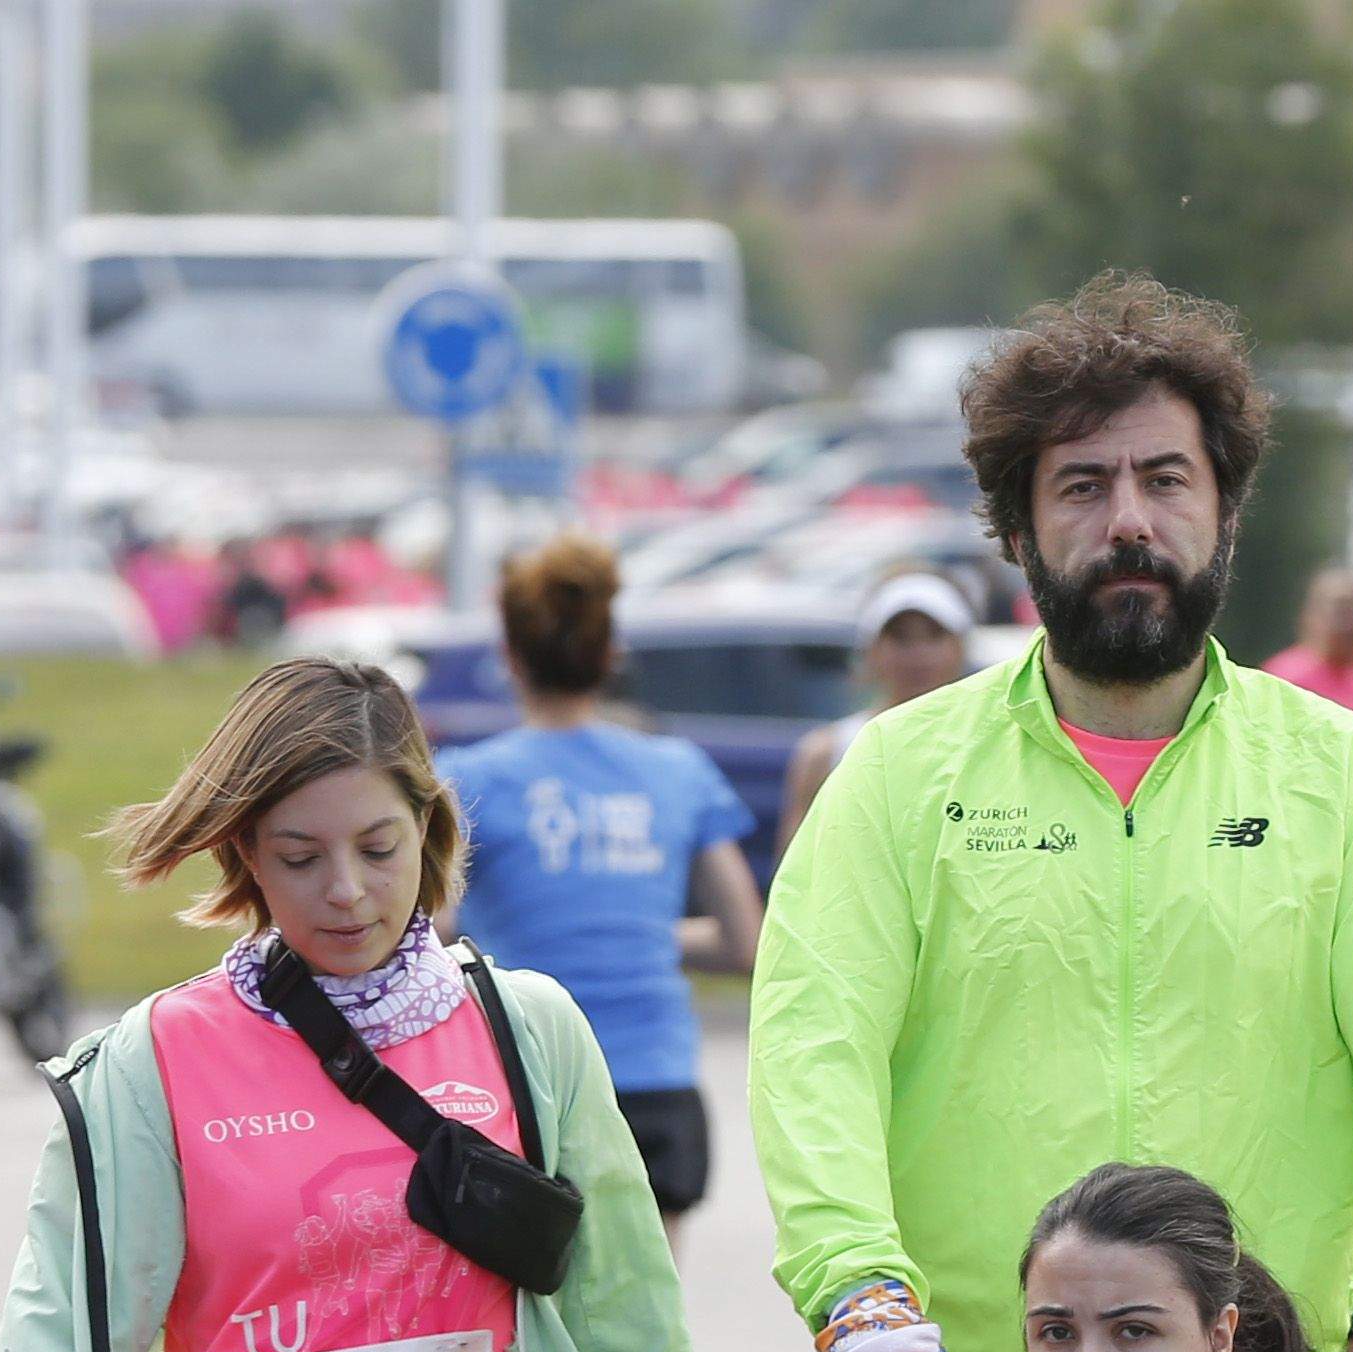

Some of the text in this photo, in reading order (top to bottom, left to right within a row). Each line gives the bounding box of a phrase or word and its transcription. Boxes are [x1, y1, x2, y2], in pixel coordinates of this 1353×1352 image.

[968, 807, 1029, 821] ZURICH
[966, 838, 1028, 852] SEVILLA
[204, 1109, 316, 1143] OYSHO
